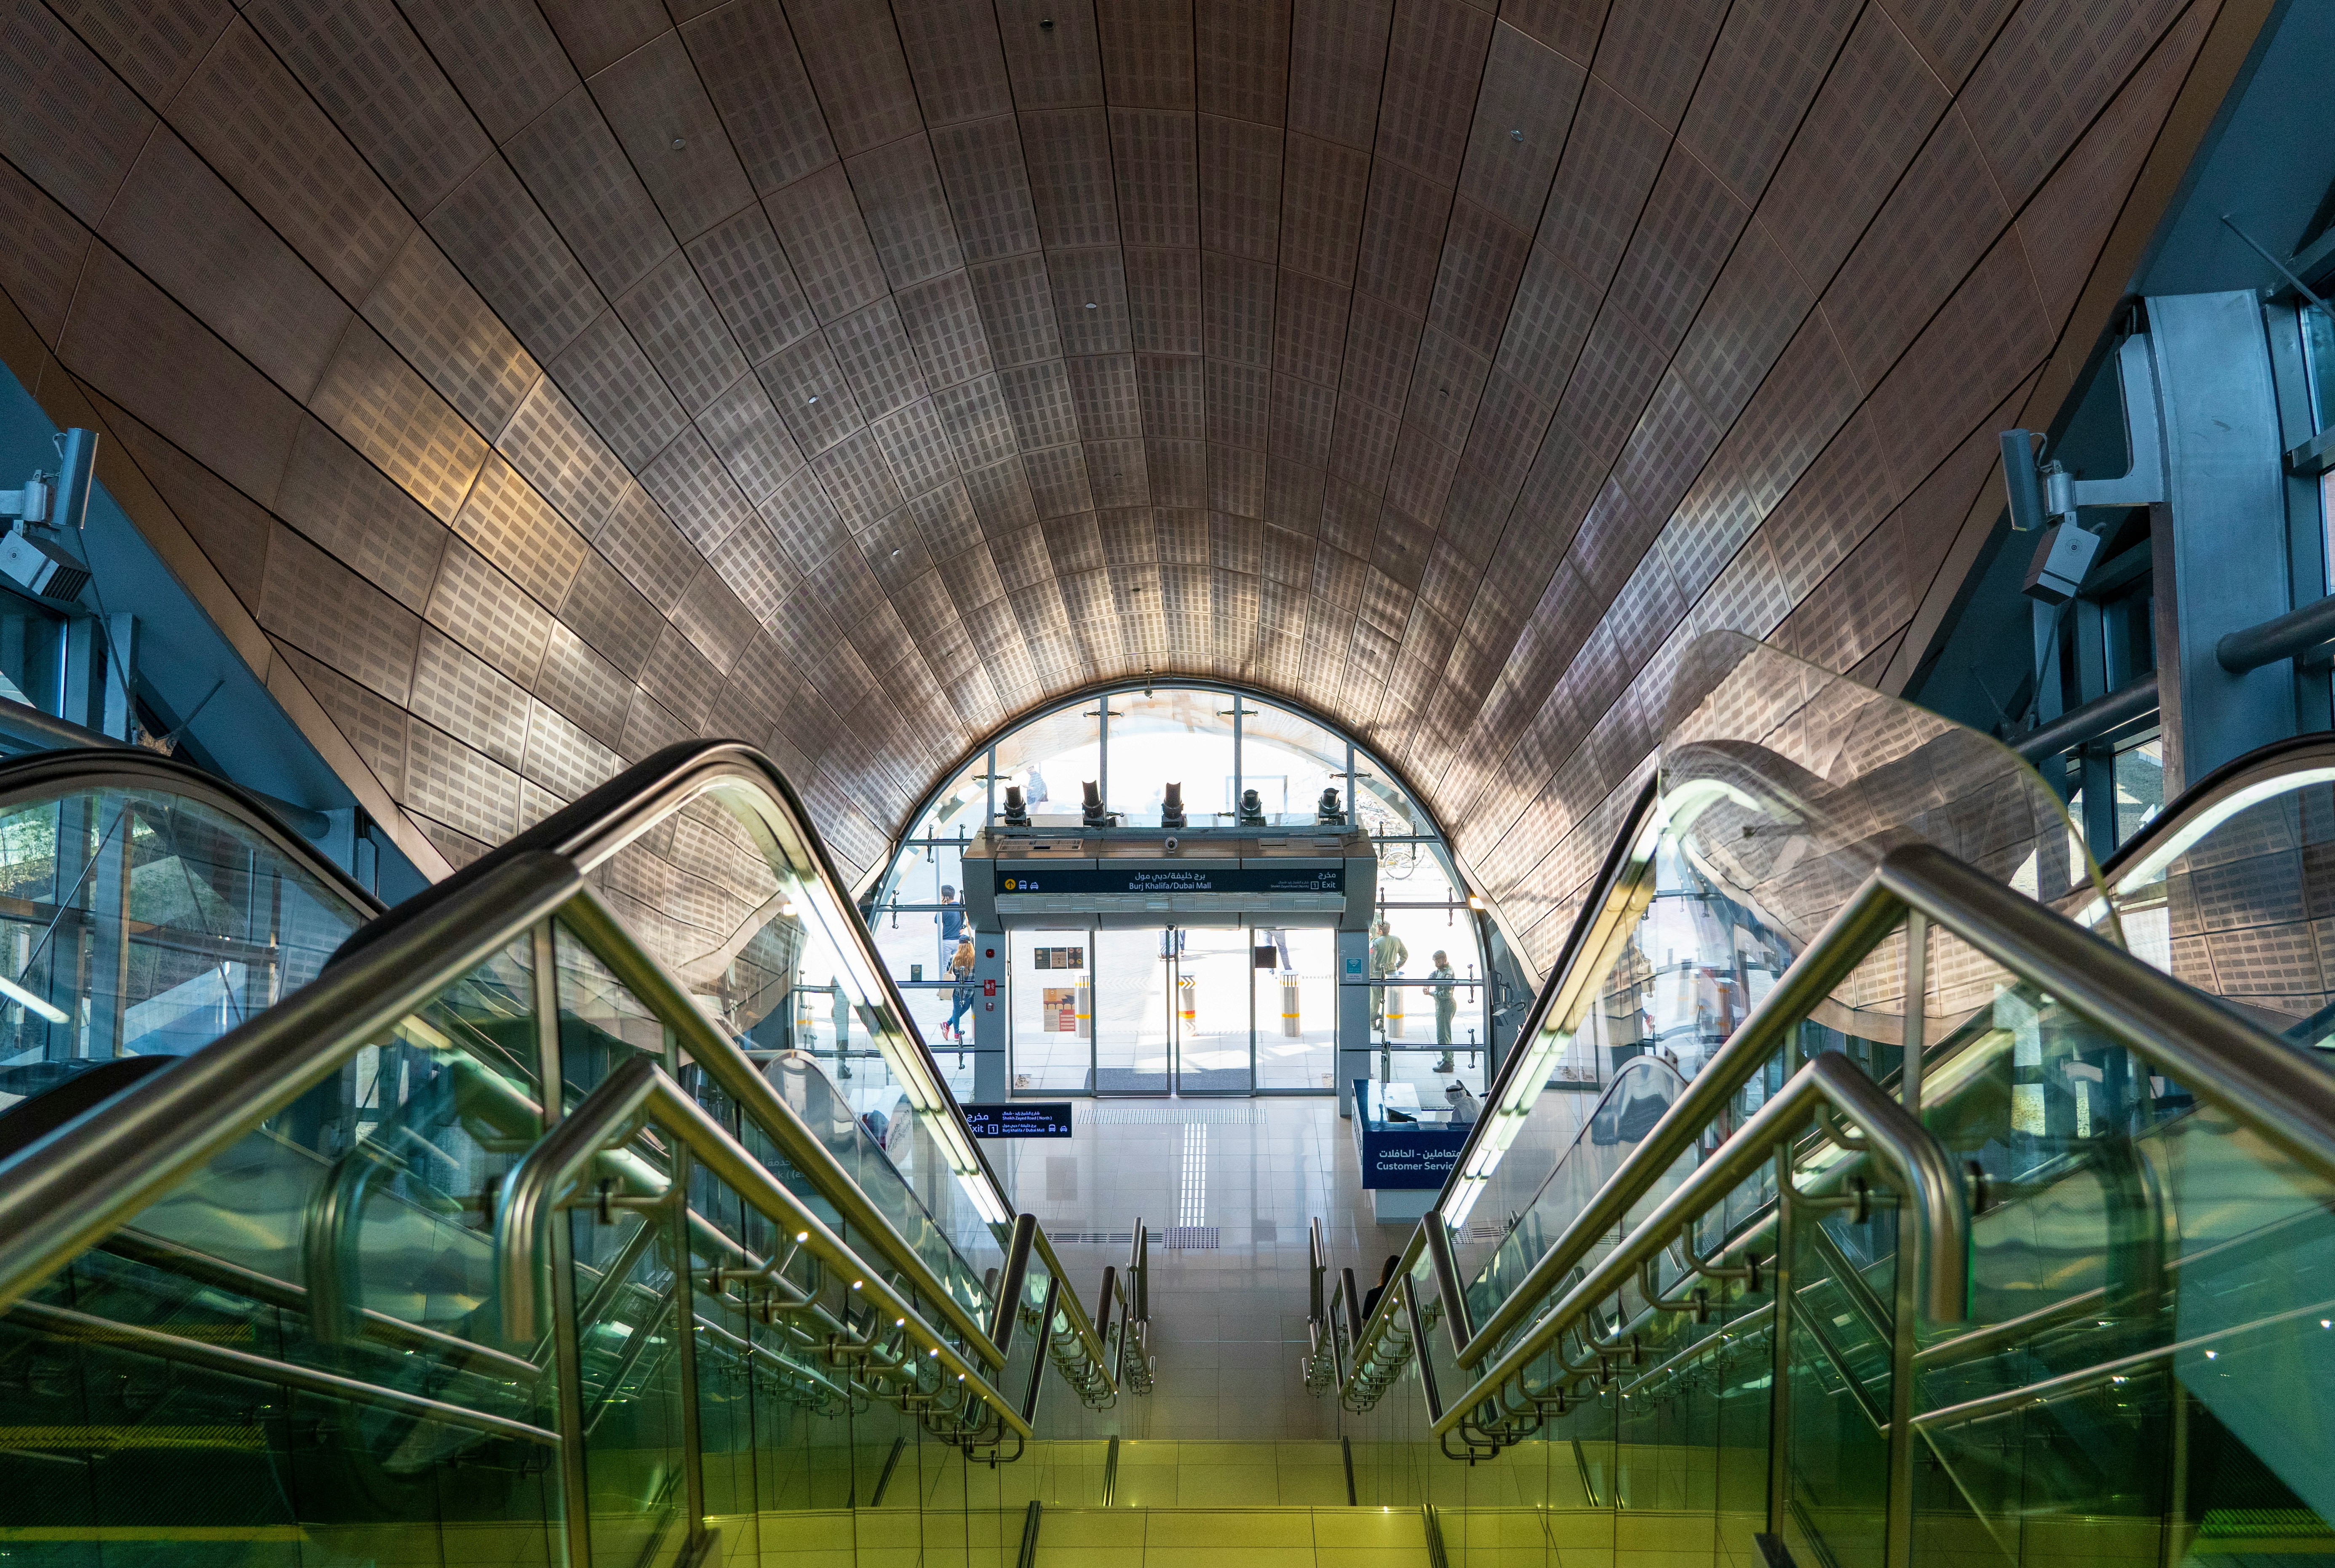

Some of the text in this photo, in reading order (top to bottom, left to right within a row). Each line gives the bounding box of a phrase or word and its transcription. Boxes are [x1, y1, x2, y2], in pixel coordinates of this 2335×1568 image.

[1135, 872, 1150, 880] مول
[1152, 872, 1192, 882] خليفة/دبي
[1318, 872, 1336, 880] مخرج
[1129, 883, 1143, 891] Burj
[967, 1113, 989, 1122] مخرج
[1379, 1149, 1414, 1157] الحافلات
[1376, 1162, 1453, 1170] Customer Servic
